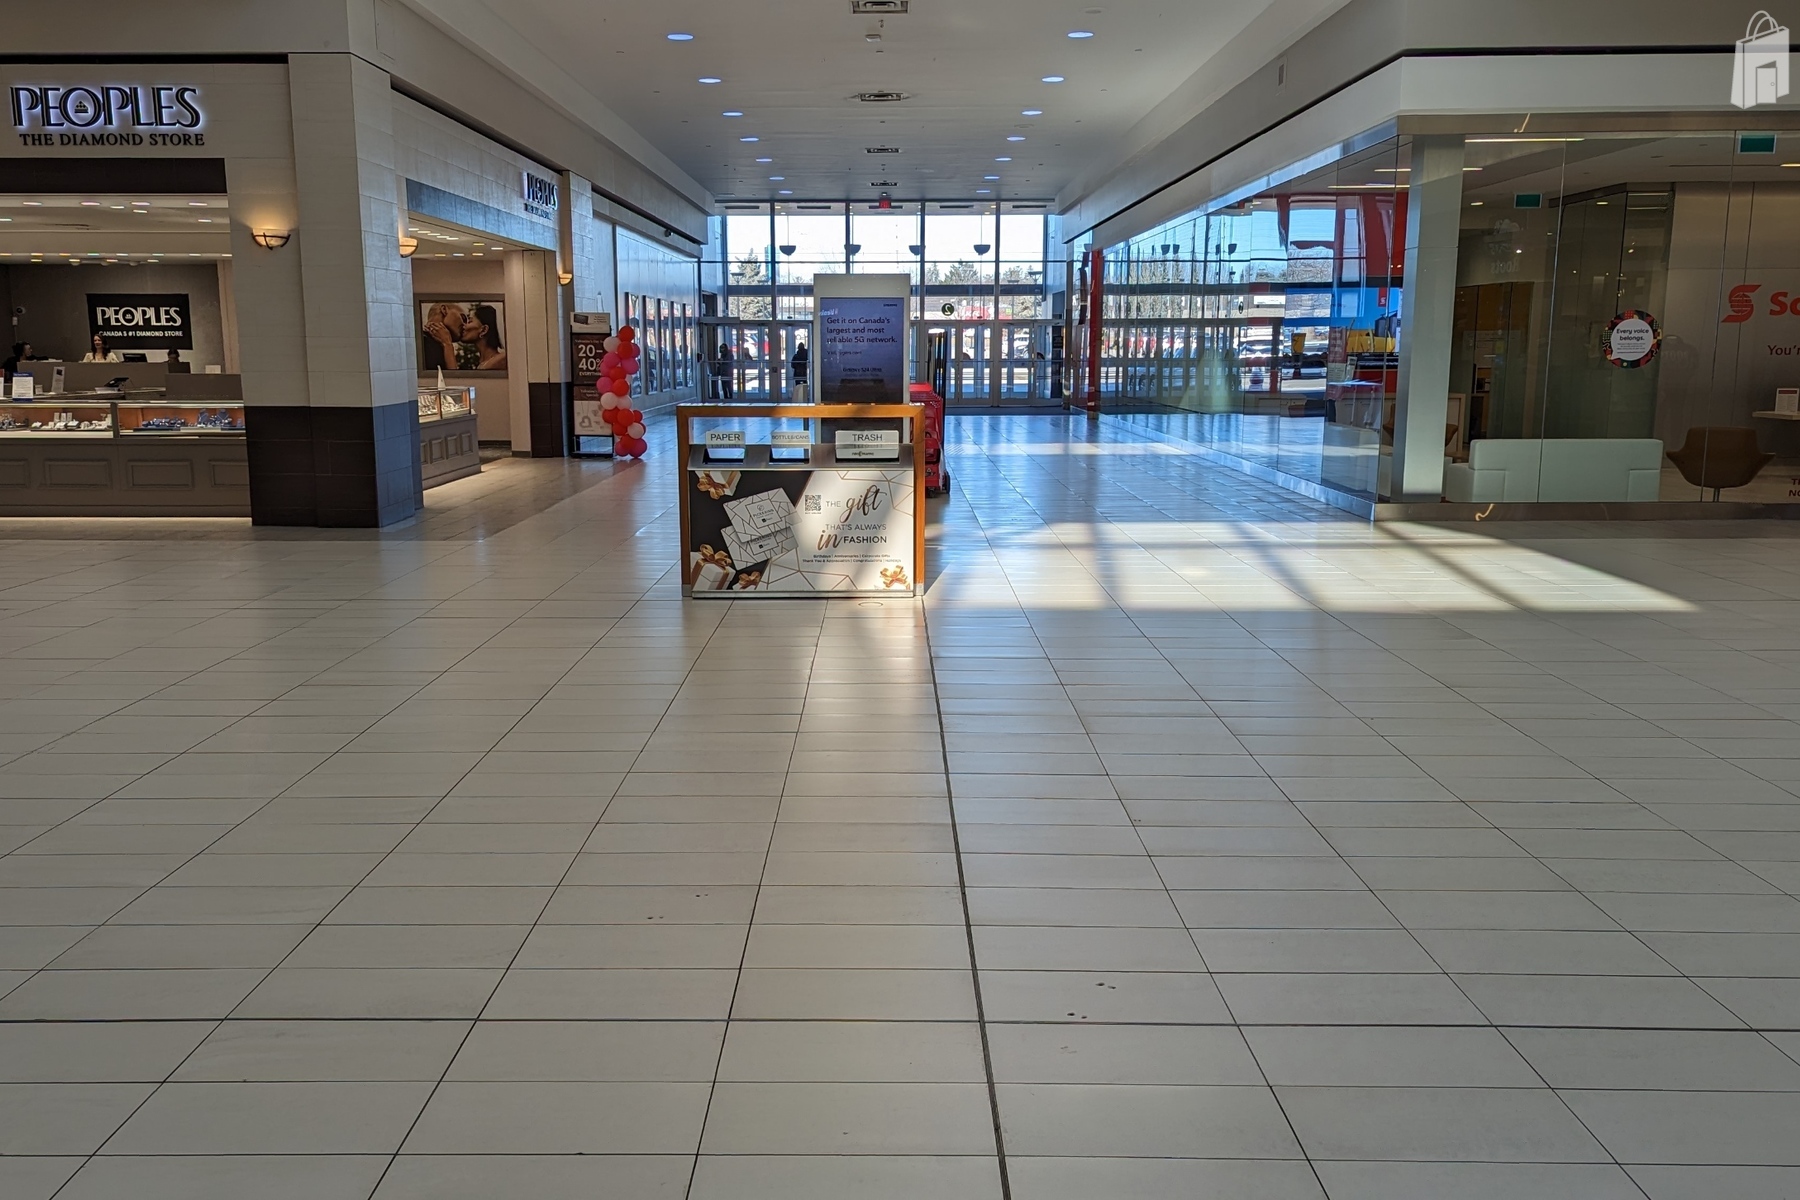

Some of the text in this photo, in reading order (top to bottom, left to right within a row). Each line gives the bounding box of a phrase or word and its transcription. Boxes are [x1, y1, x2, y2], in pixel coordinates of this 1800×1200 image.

[10, 86, 202, 128] PEOPLES
[19, 133, 205, 146] THE DIAMOND STORE
[97, 307, 182, 327] PEOPLES
[827, 316, 841, 324] Get
[858, 316, 891, 324] Canada's
[826, 326, 852, 336] largest
[852, 326, 866, 334] and
[866, 335, 898, 343] network.
[578, 357, 604, 371] 40%
[710, 433, 741, 442] PAPER
[852, 433, 883, 442] TRASH
[825, 484, 888, 523] THE gift
[825, 523, 887, 531] THAT'S ALWAYS
[817, 529, 887, 551] in FASHION
